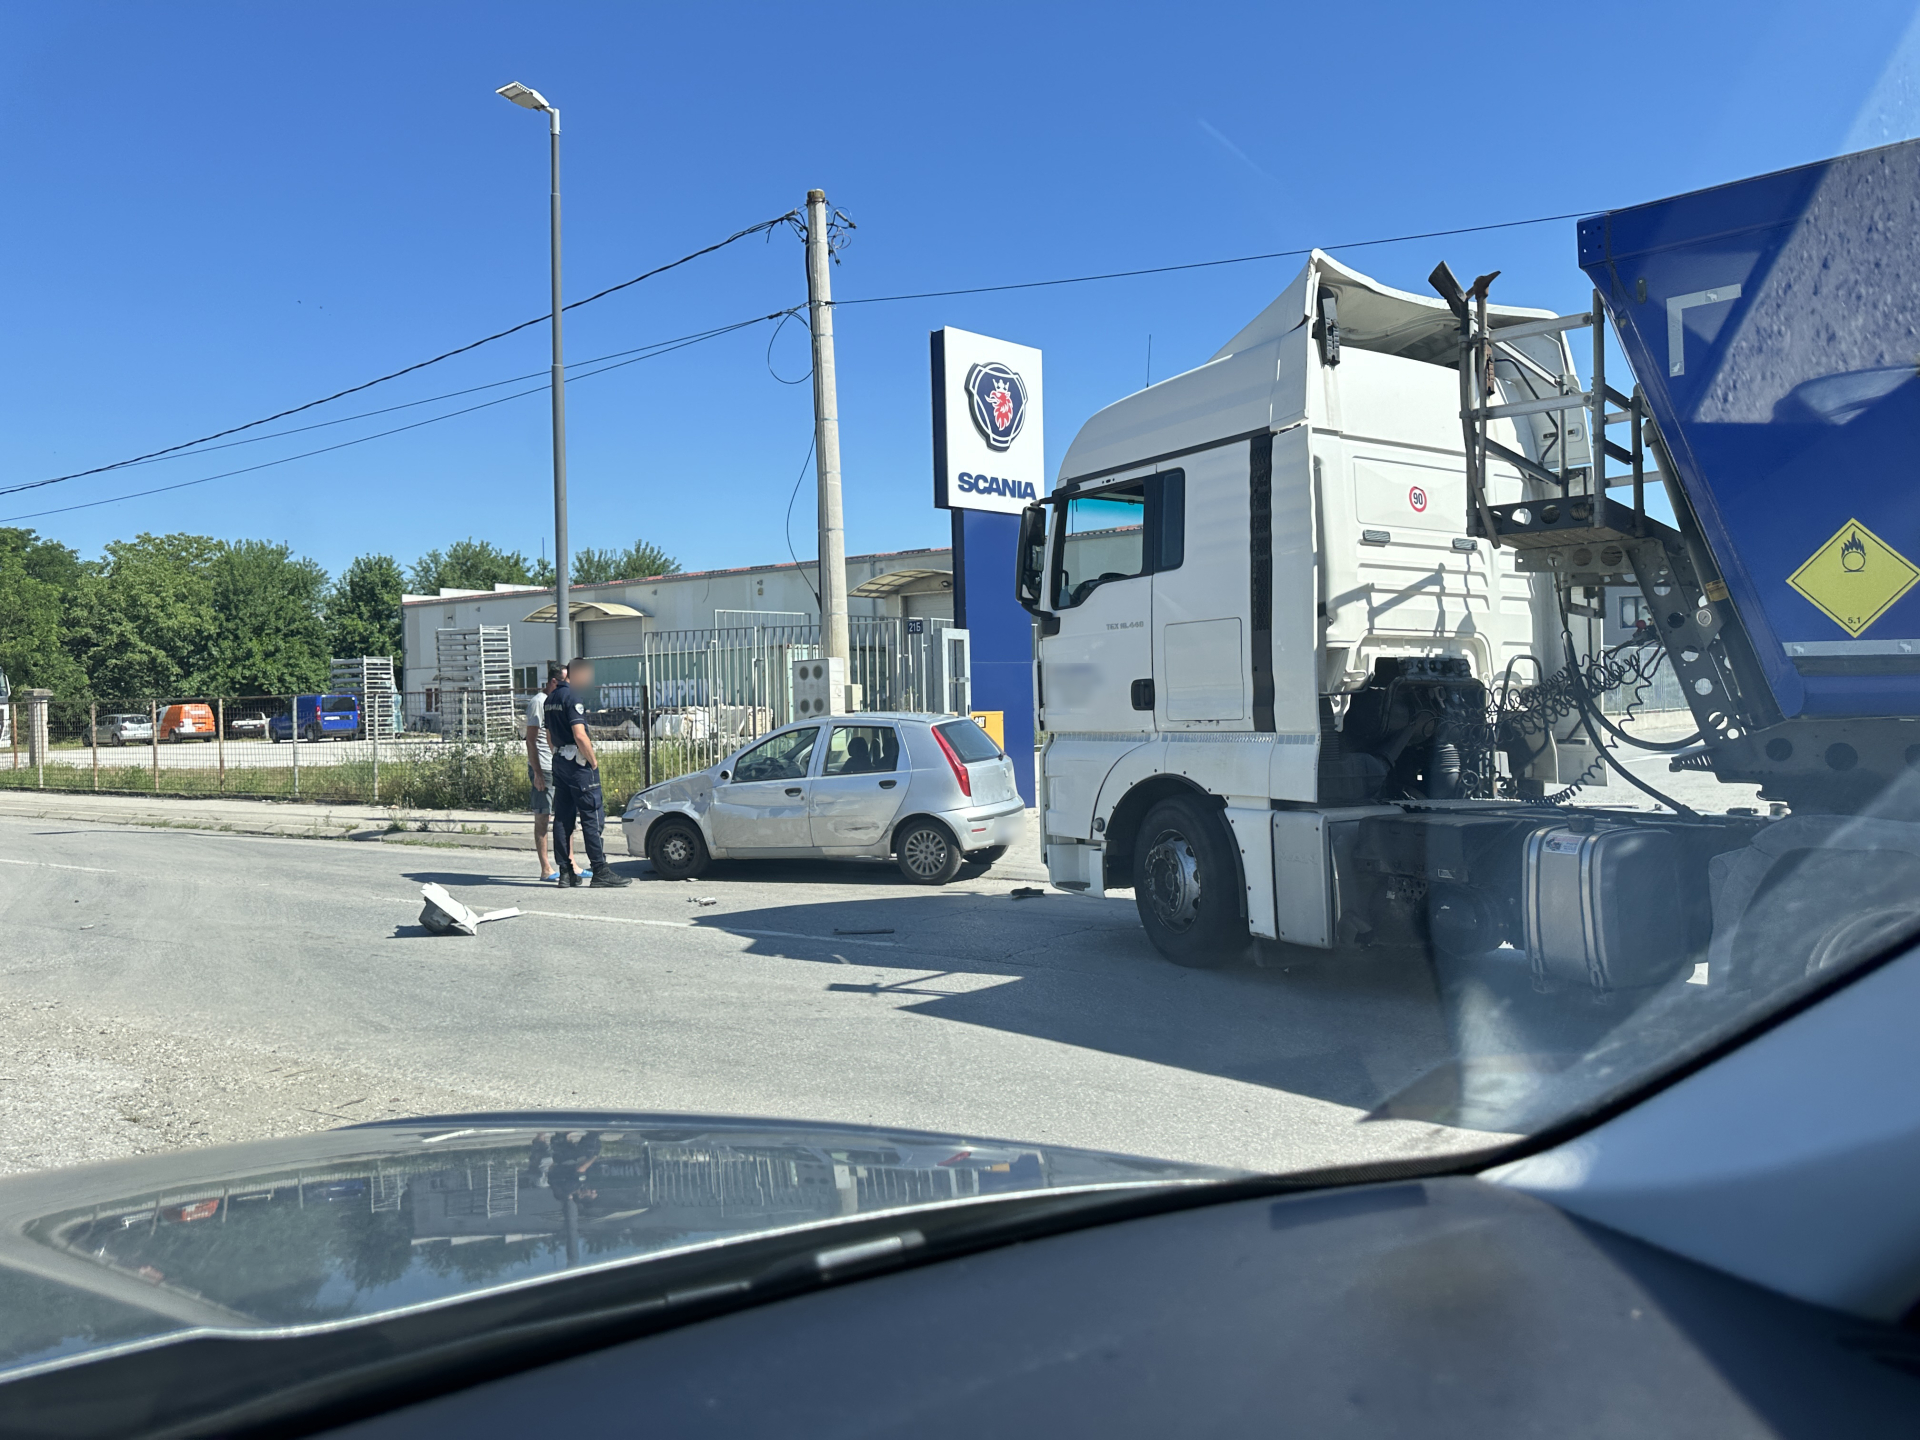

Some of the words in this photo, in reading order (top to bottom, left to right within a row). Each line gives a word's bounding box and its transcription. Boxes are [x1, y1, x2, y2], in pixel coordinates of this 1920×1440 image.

[958, 472, 1037, 501] SCANIA
[1413, 492, 1423, 505] 90
[1847, 616, 1861, 624] 5.1
[600, 682, 642, 708] CHINA
